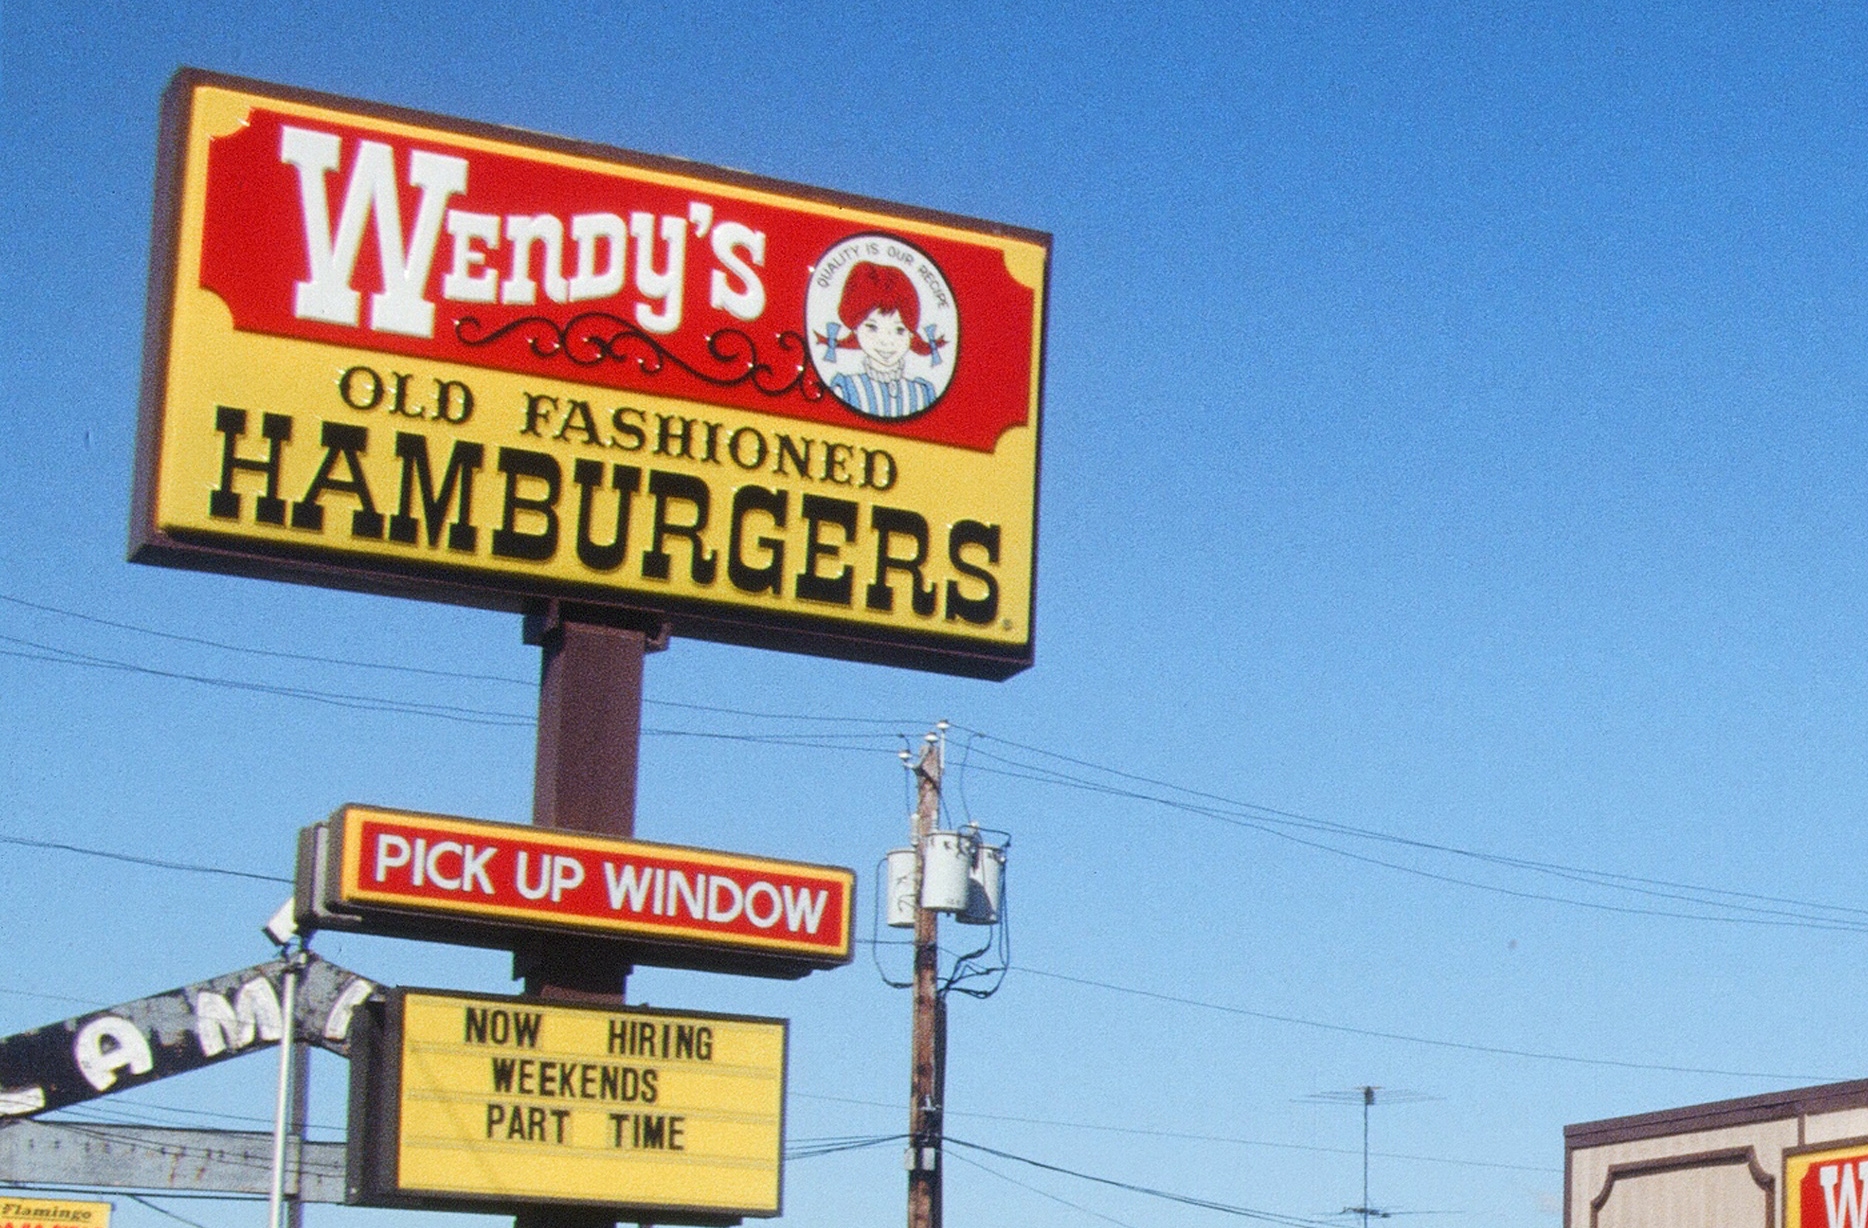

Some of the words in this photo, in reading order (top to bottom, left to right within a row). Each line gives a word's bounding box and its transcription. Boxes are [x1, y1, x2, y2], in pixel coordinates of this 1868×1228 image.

[817, 246, 859, 288] QUALITY
[866, 244, 879, 255] IS
[887, 246, 914, 266] OUR
[918, 265, 948, 309] RECIPE
[338, 365, 474, 424] OLD
[522, 394, 899, 492] FASHIONED
[210, 406, 1002, 627] HAMBURGERS
[375, 833, 498, 895] PICK
[515, 851, 585, 903] UP
[603, 861, 828, 935] WINDOW
[464, 1007, 543, 1048] NOW
[608, 1019, 714, 1061] HIRING
[491, 1057, 658, 1103] WEEKENDS
[487, 1103, 570, 1144] PART
[609, 1113, 685, 1150] TIME
